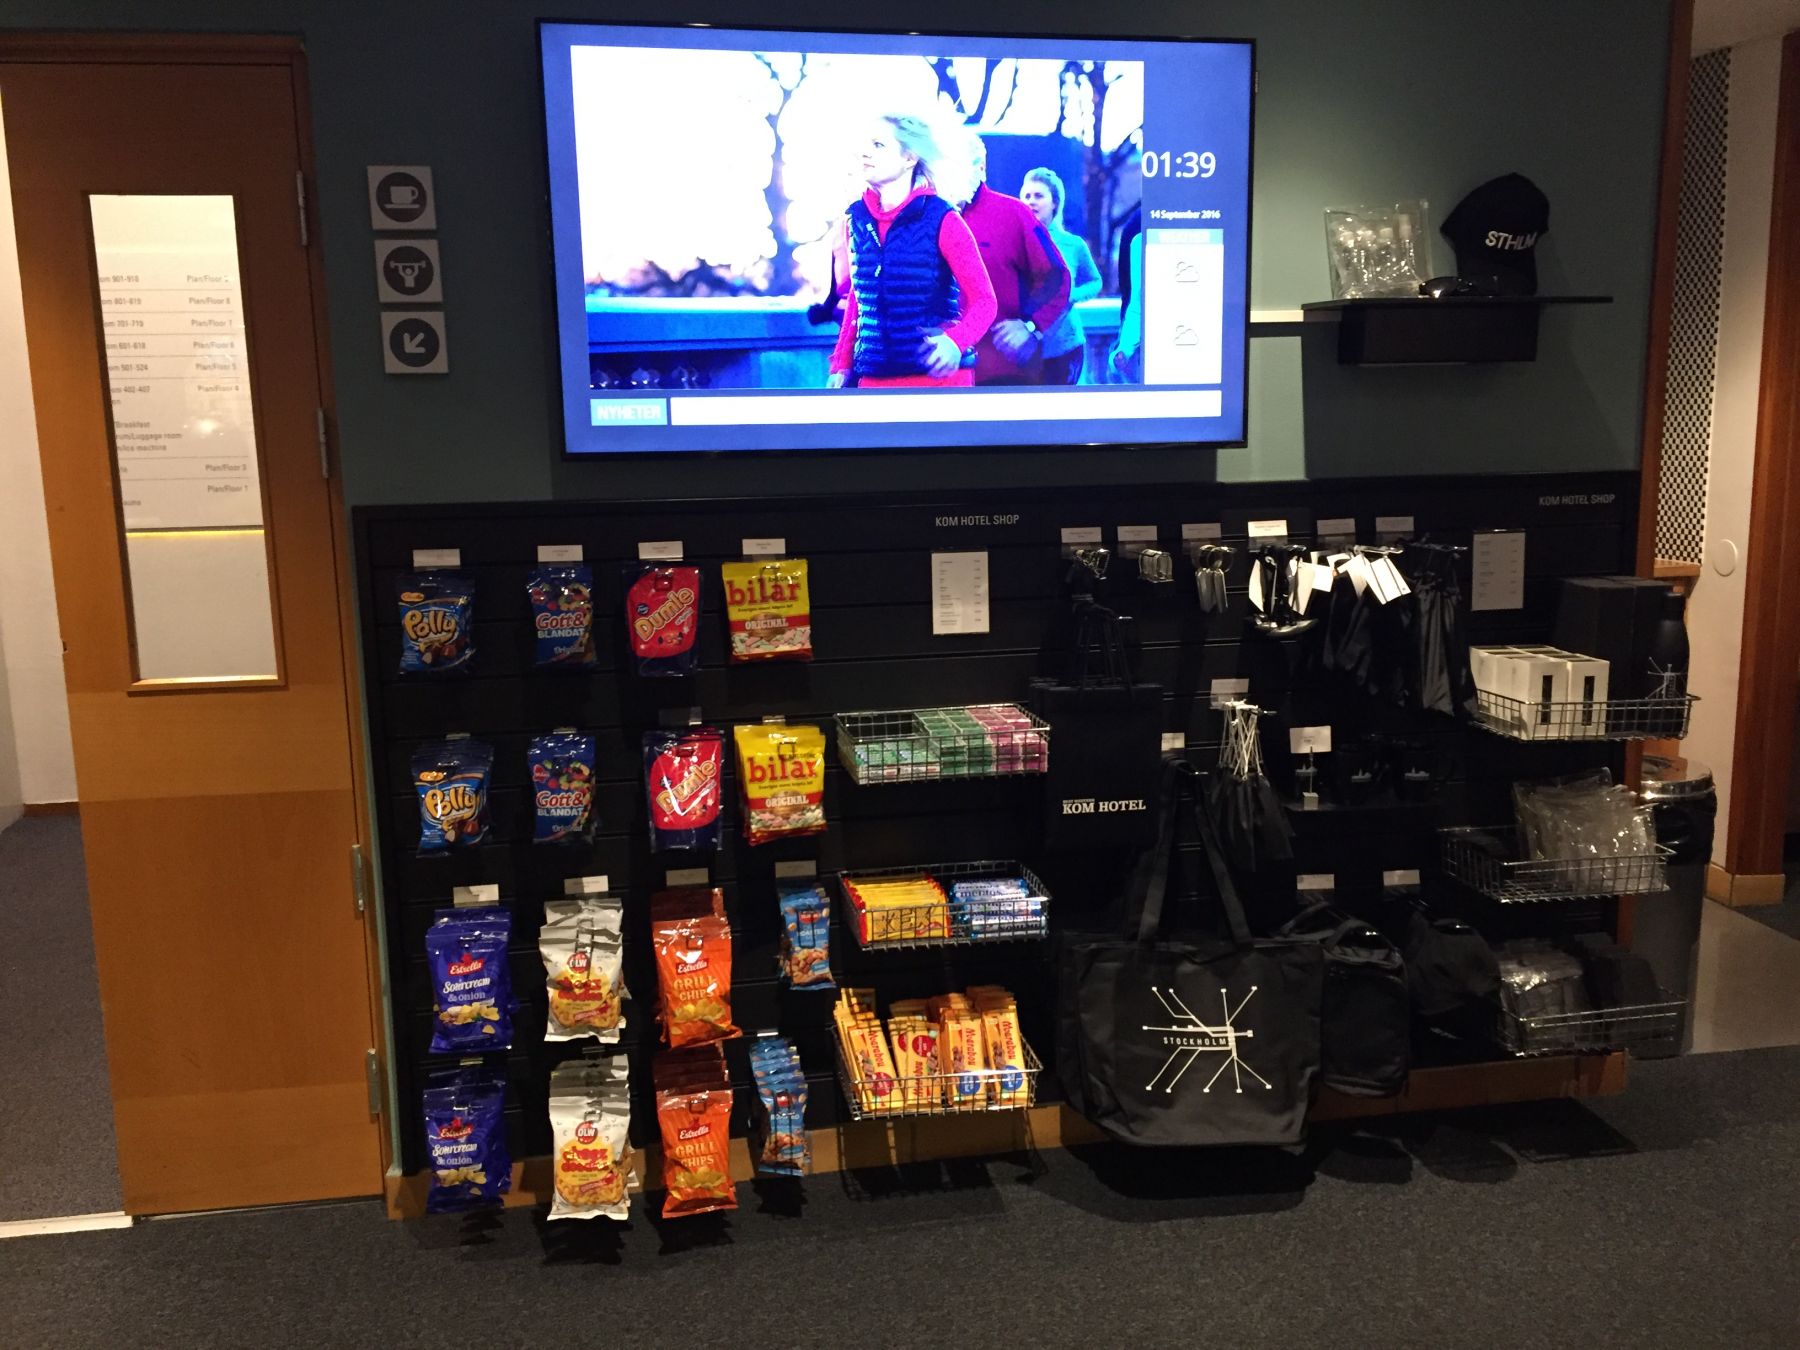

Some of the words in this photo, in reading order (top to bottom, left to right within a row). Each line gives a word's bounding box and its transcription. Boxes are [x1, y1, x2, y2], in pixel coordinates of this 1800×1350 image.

[1141, 151, 1217, 178] 01:39
[1150, 210, 1160, 219] 14
[1161, 210, 1200, 220] September
[1201, 210, 1221, 219] 2016
[1539, 496, 1561, 506] KOM
[1561, 494, 1589, 505] HOTEL
[1590, 494, 1616, 504] SHOP
[935, 516, 959, 527] KOM
[960, 515, 992, 526] HOTEL
[993, 514, 1020, 525] SHOP
[726, 577, 801, 606] bilar
[634, 588, 694, 641] Dumle
[404, 609, 458, 643] Polly
[744, 618, 789, 631] ORIGINAL
[537, 628, 586, 639] BLANDAT
[747, 754, 817, 784] bilar
[424, 786, 481, 820] Polly
[765, 795, 809, 808] ORIGINAL
[1062, 802, 1095, 815] KOM
[1098, 799, 1147, 812] HOTEL
[537, 807, 585, 817] BLANDAT
[450, 962, 483, 975] Estrella
[676, 961, 708, 974] Estrella
[443, 977, 491, 994] Sourcream
[458, 991, 486, 1001] onion
[679, 989, 714, 1001] CHIPS
[965, 1028, 976, 1066] Marabou
[1003, 1021, 1016, 1060] Marabou
[1163, 1037, 1226, 1046] STOCKHOLM
[868, 1031, 885, 1067] Marabou
[578, 1128, 595, 1137] OLW
[679, 1126, 709, 1140] Estrella
[446, 1156, 473, 1165] onion
[680, 1155, 714, 1168] CHIPS
